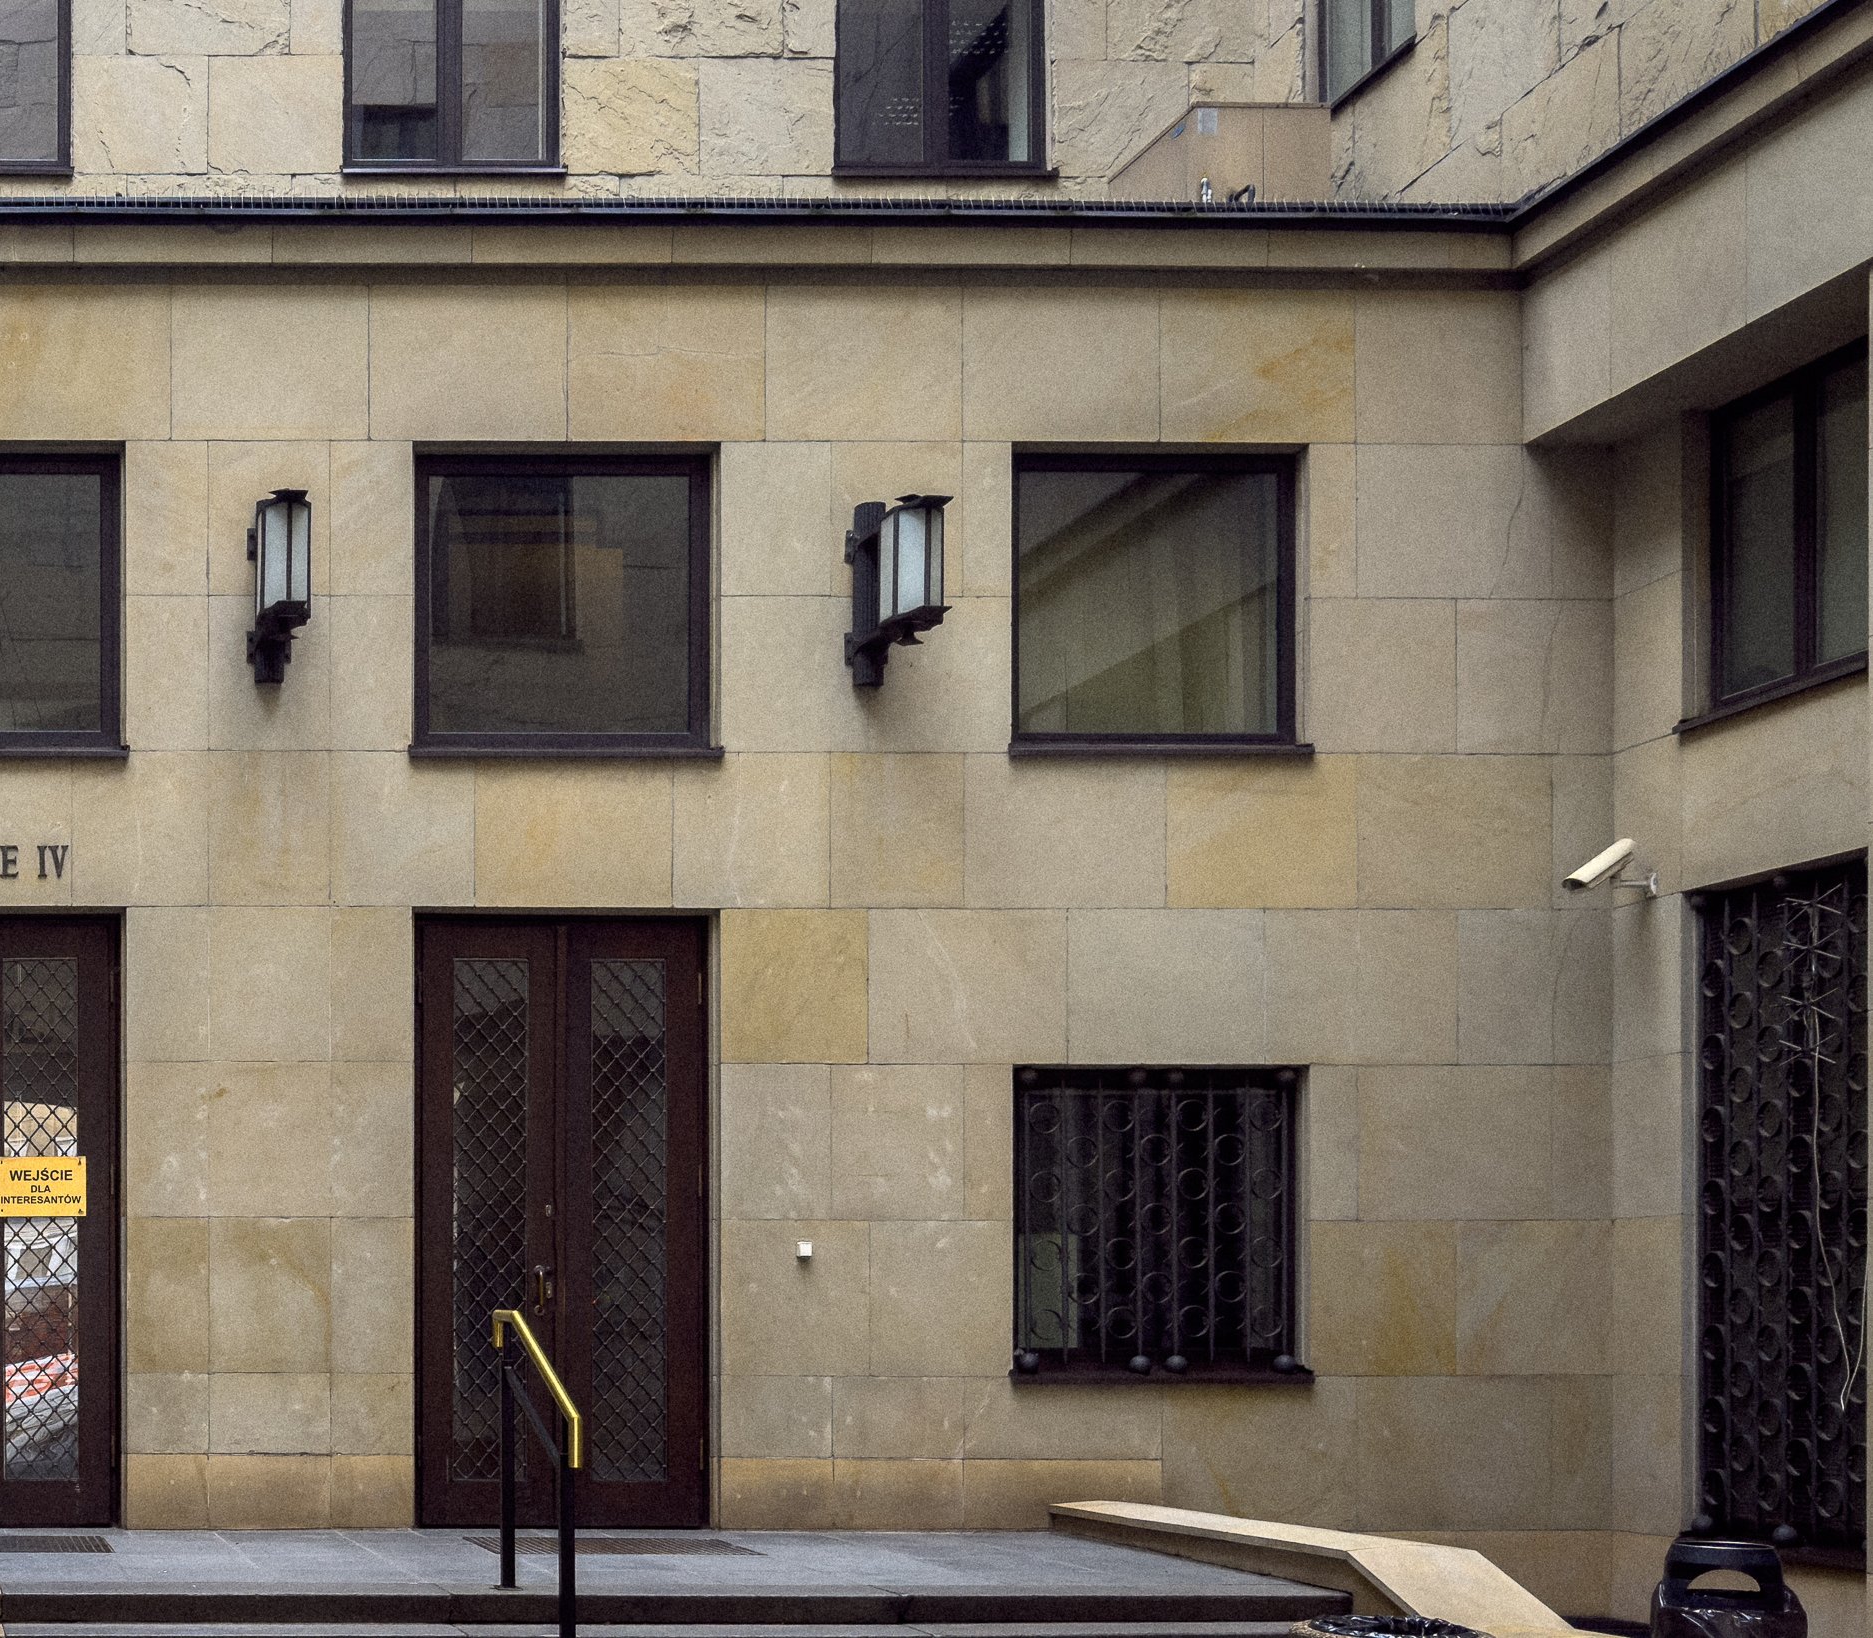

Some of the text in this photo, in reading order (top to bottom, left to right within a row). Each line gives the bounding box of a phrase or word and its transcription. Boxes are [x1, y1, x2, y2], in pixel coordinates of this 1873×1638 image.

[37, 845, 69, 879] IV
[9, 1168, 73, 1181] WEJŚCIE
[30, 1185, 51, 1193] DLA
[0, 1195, 82, 1204] INTERESANTÓW
